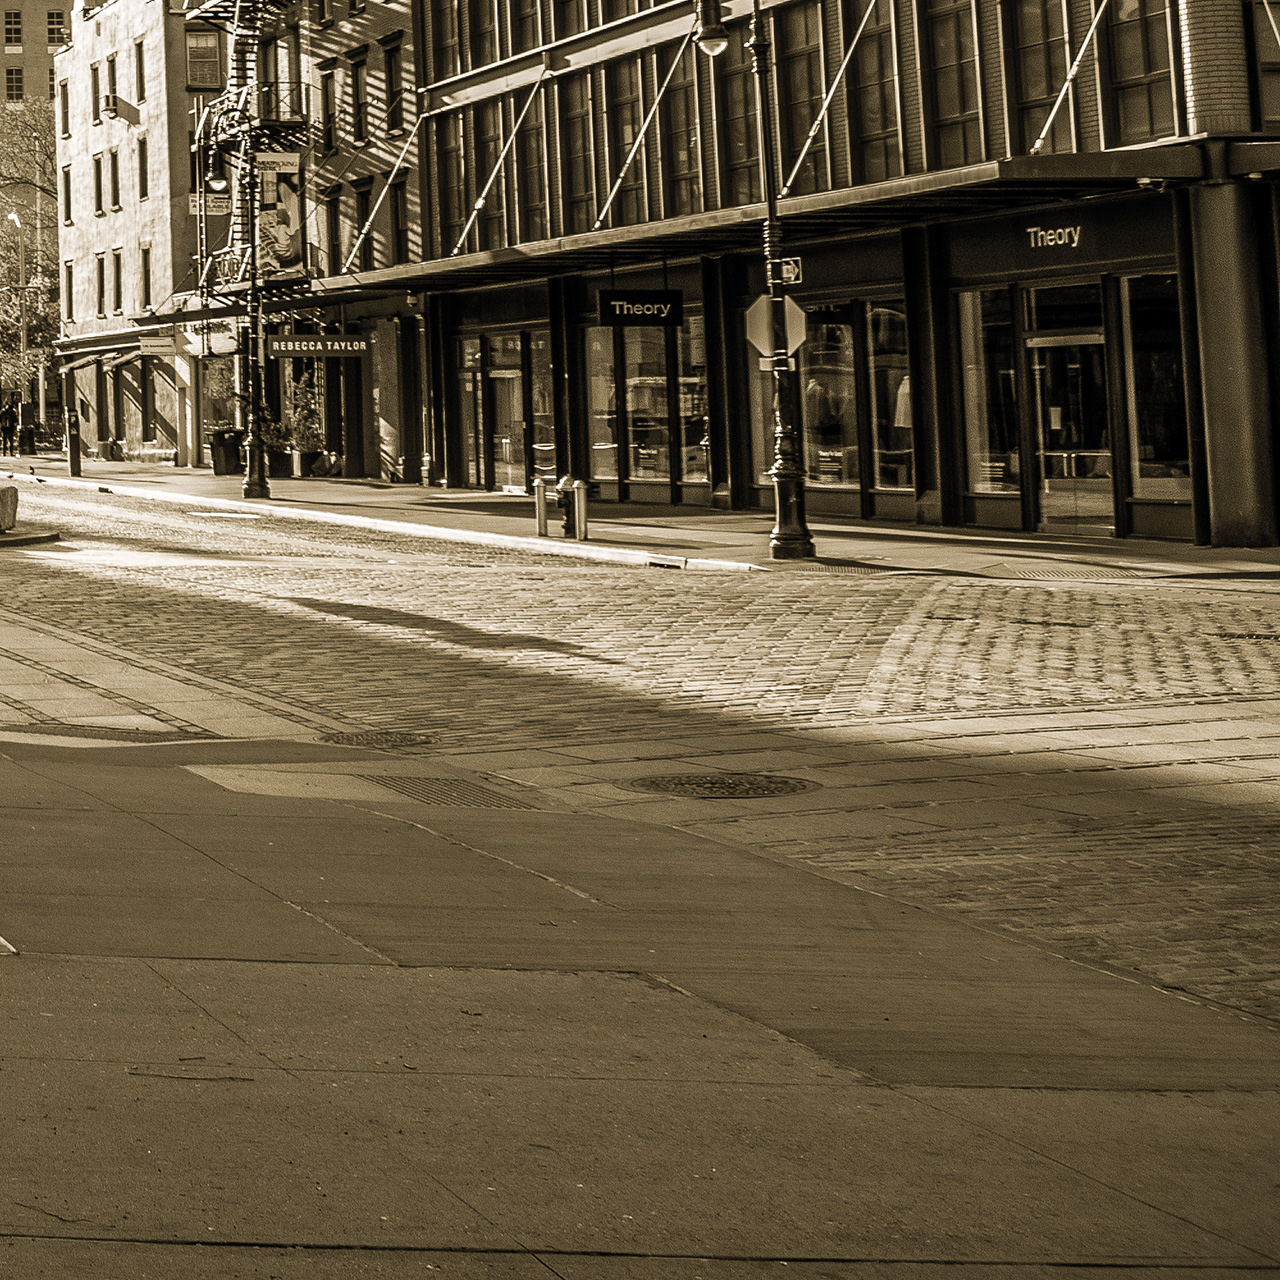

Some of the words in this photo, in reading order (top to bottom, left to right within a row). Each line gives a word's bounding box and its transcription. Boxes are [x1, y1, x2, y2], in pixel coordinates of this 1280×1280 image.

[1025, 225, 1082, 248] Theory
[610, 300, 672, 317] Theory
[272, 341, 323, 351] REBECCA
[326, 341, 367, 351] TAYLOR
